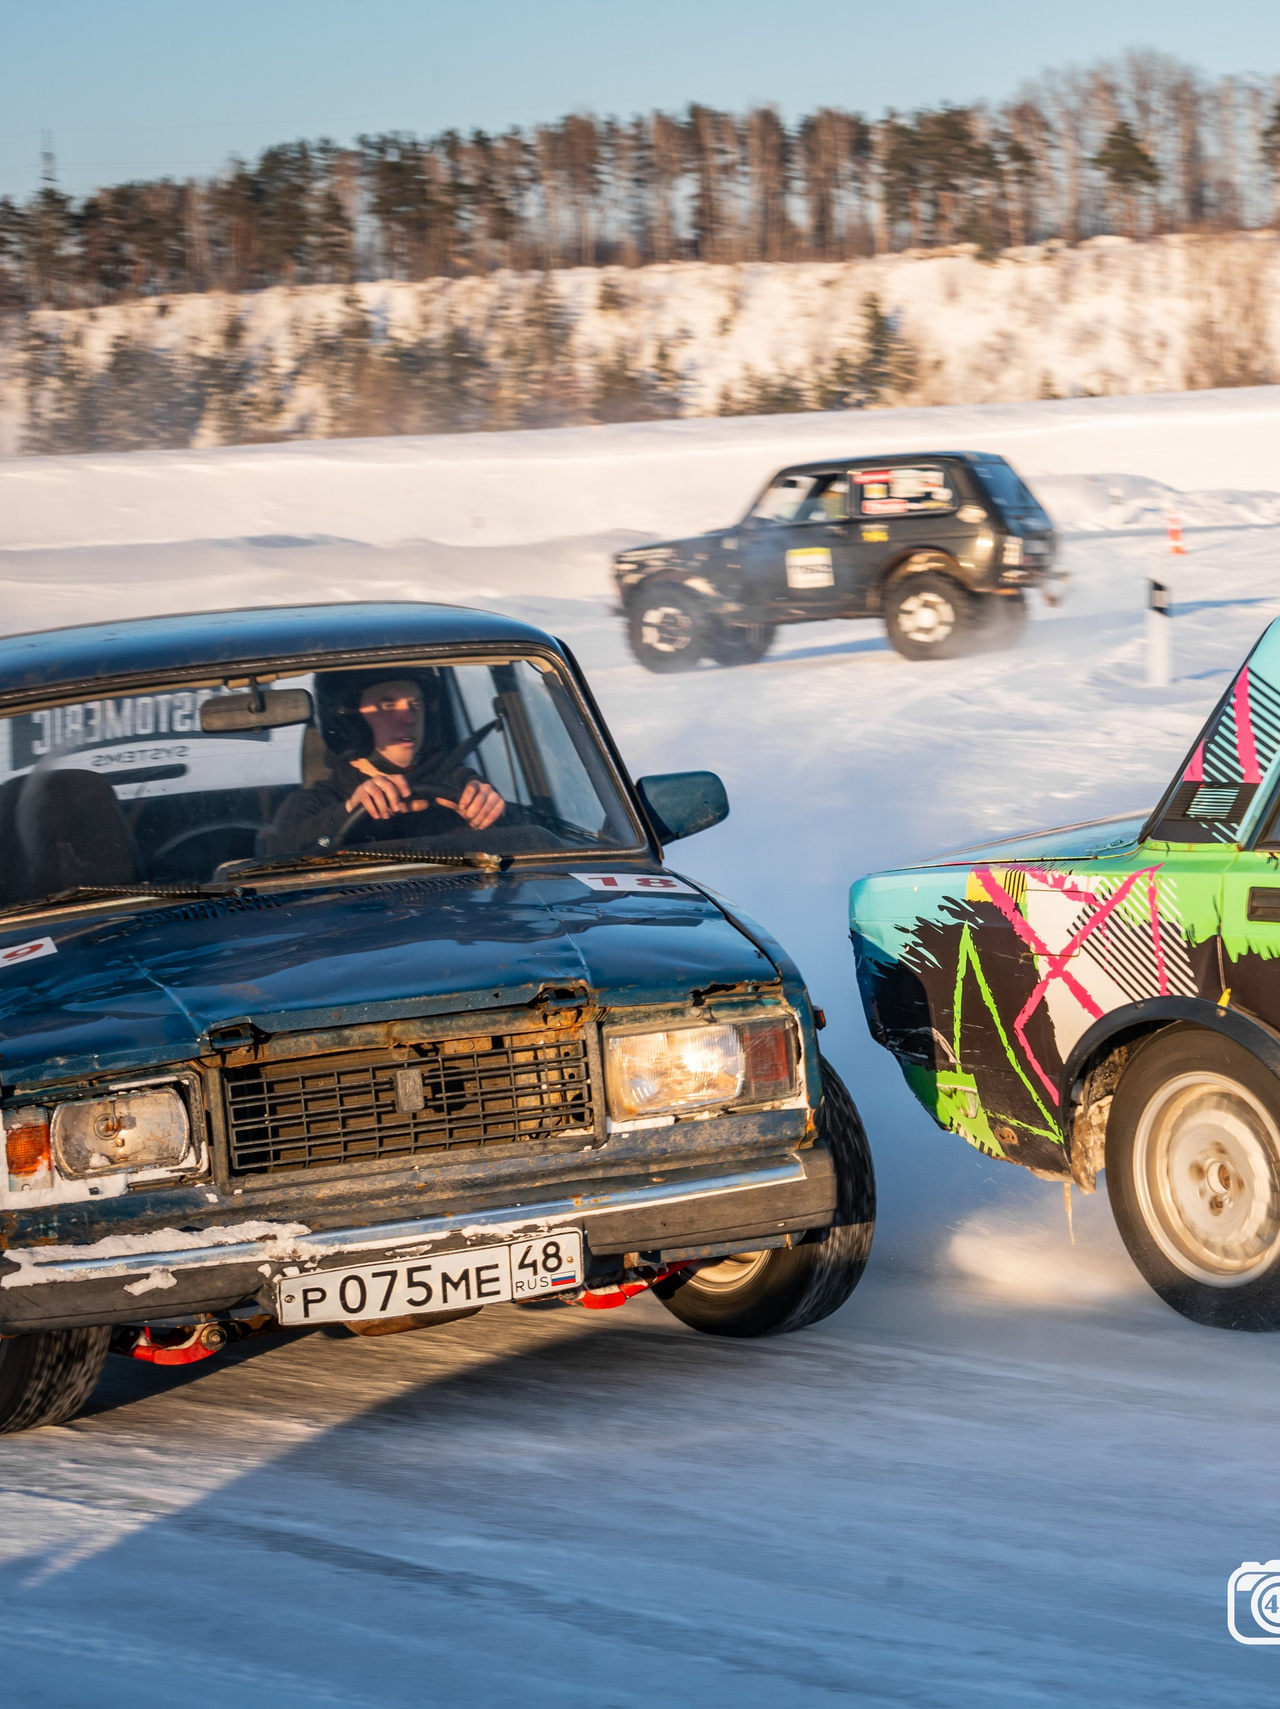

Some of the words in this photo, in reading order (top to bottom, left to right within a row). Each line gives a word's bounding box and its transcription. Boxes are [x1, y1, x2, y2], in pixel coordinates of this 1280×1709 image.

[588, 876, 678, 888] 18
[517, 1240, 563, 1276] 48
[515, 1276, 549, 1293] RUS
